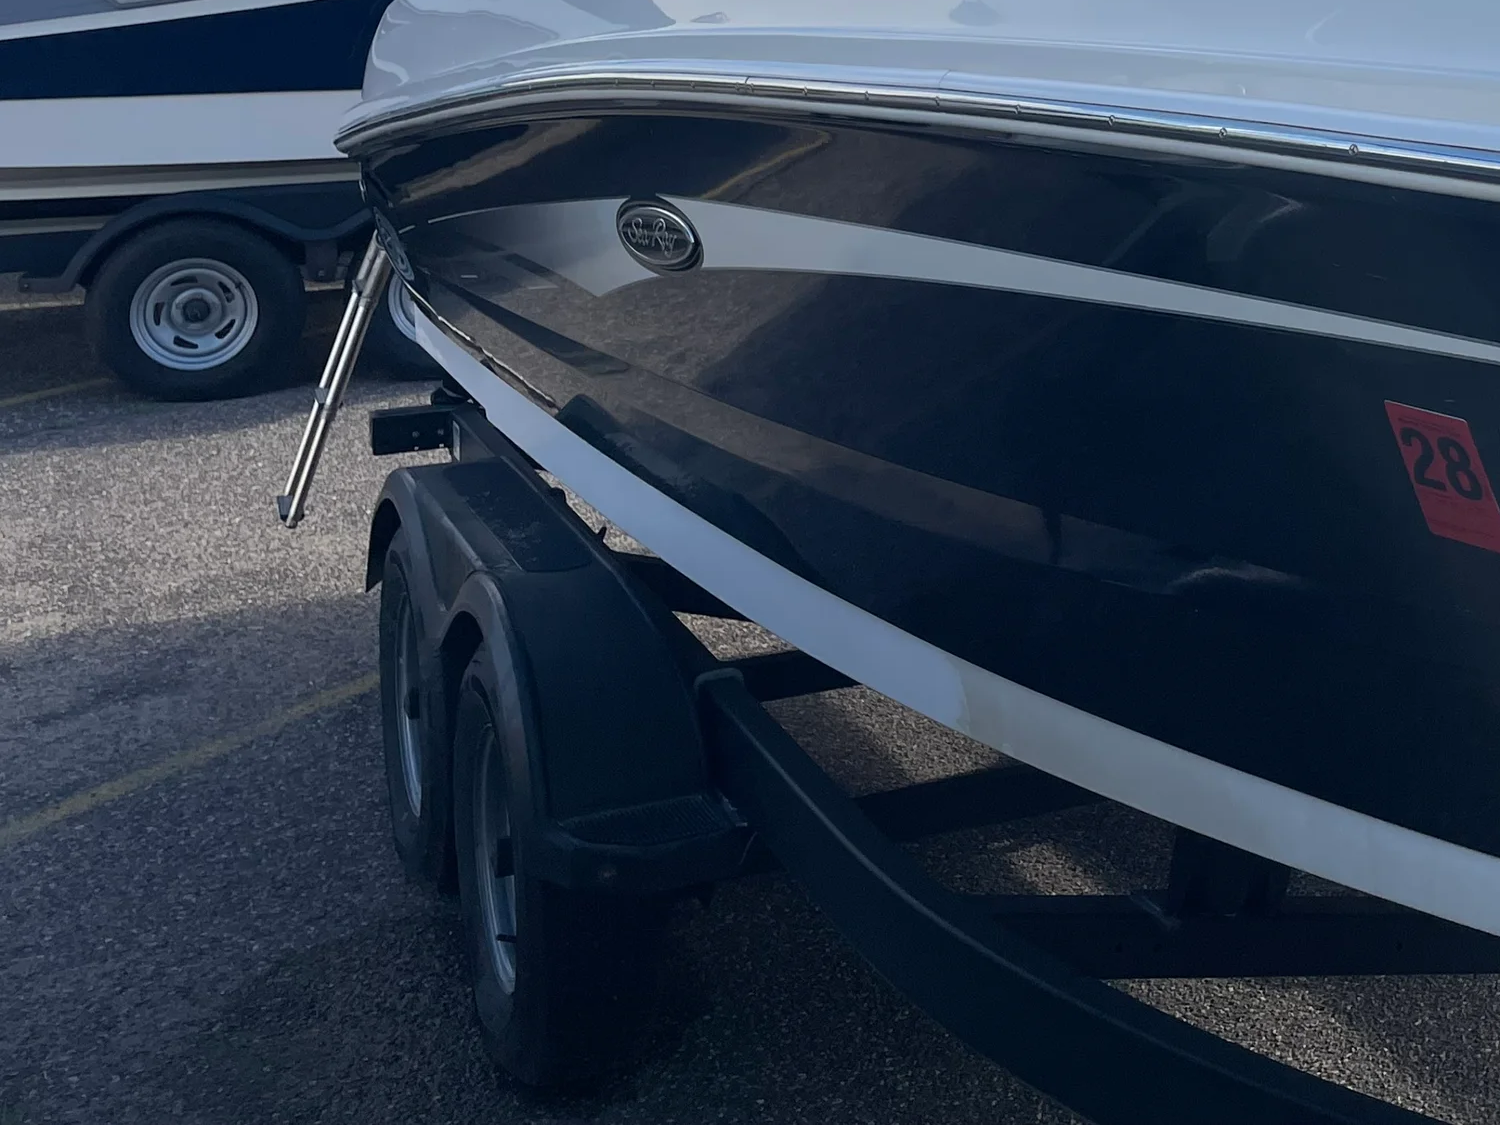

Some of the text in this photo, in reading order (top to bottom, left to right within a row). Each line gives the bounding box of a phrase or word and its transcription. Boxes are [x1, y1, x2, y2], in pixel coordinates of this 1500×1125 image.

[628, 217, 677, 259] Sea Ray
[1399, 426, 1484, 500] 28
